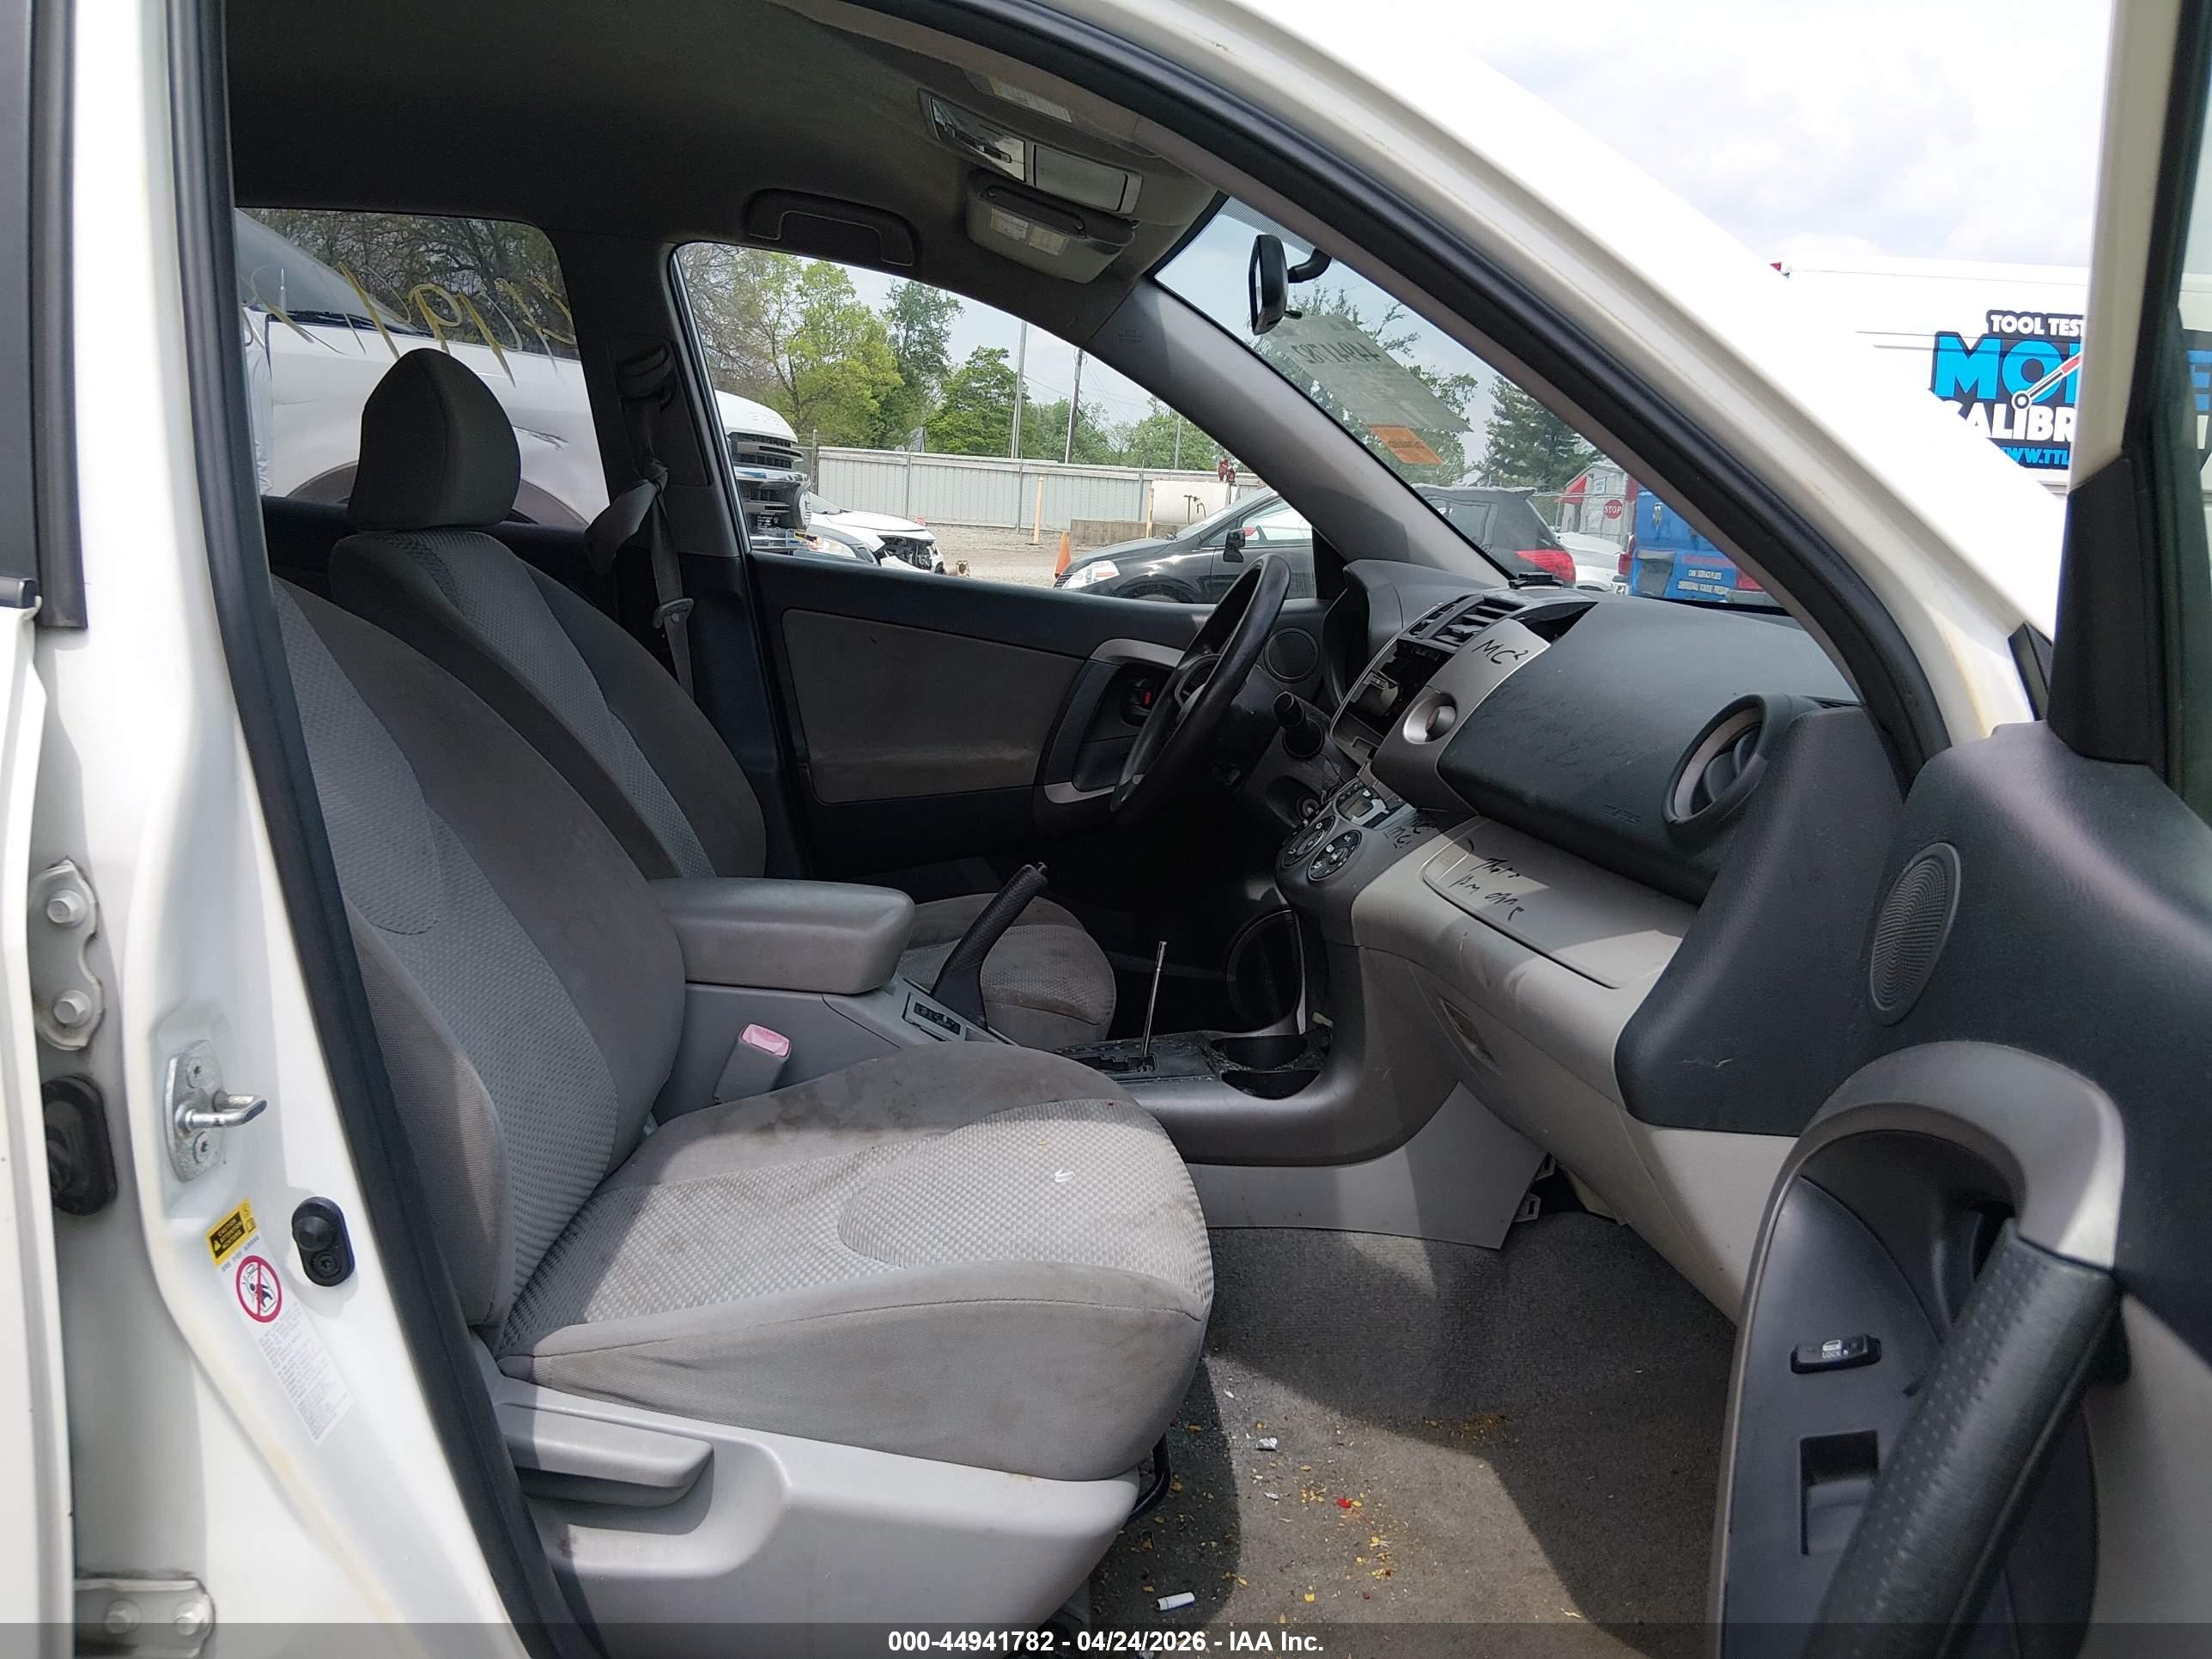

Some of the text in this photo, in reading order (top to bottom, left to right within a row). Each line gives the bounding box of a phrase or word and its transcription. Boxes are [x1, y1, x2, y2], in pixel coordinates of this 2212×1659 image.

[1990, 314, 2045, 335] TOOL
[2002, 447, 2069, 465] WW.TTL
[1603, 505, 1622, 514] STOP
